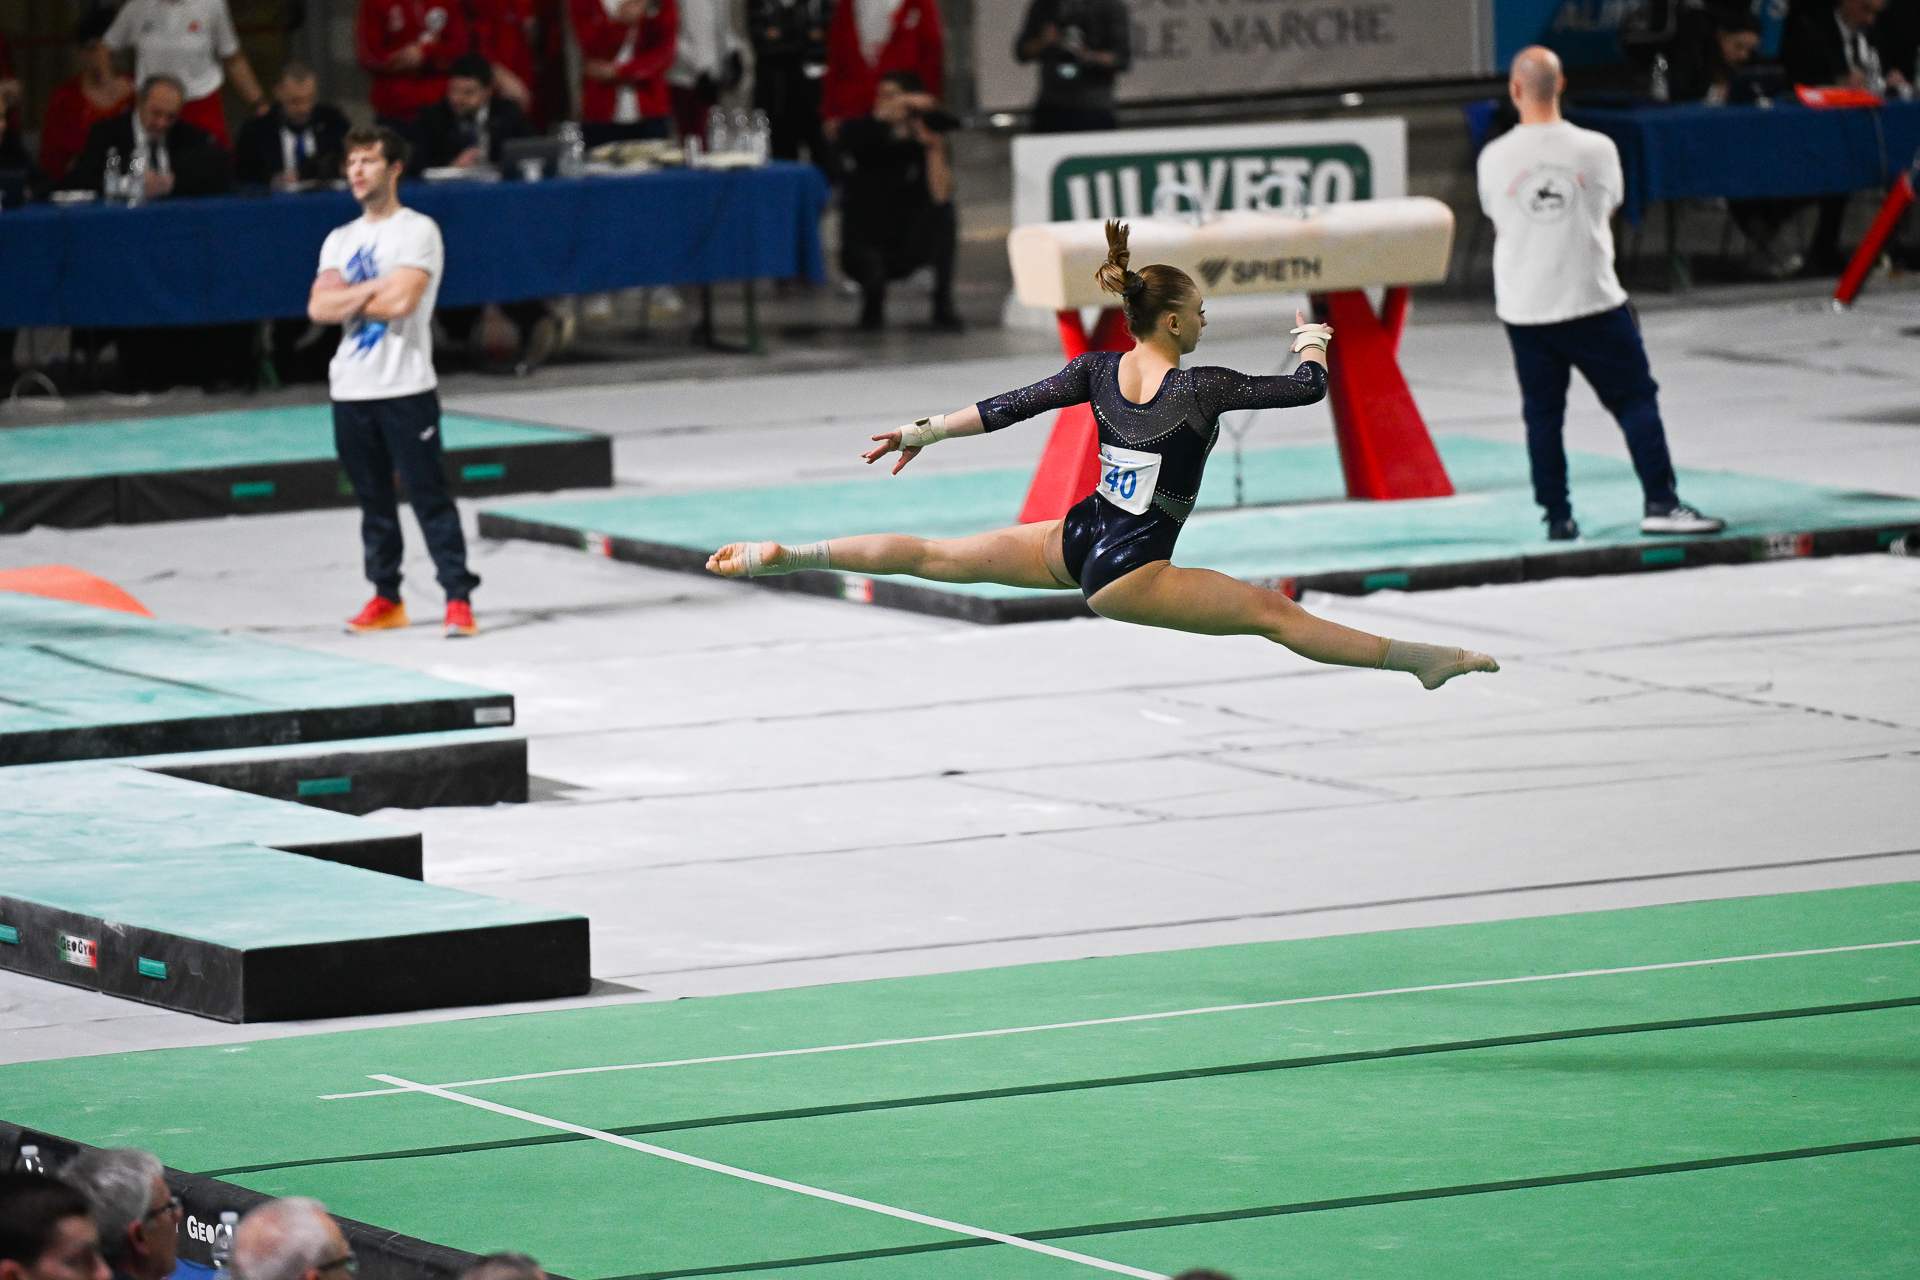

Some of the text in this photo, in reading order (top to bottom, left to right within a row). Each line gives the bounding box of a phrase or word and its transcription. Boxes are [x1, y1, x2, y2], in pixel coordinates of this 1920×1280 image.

[1207, 6, 1397, 52] MARCHE
[1232, 256, 1322, 284] SPIETH
[1105, 466, 1137, 499] 40
